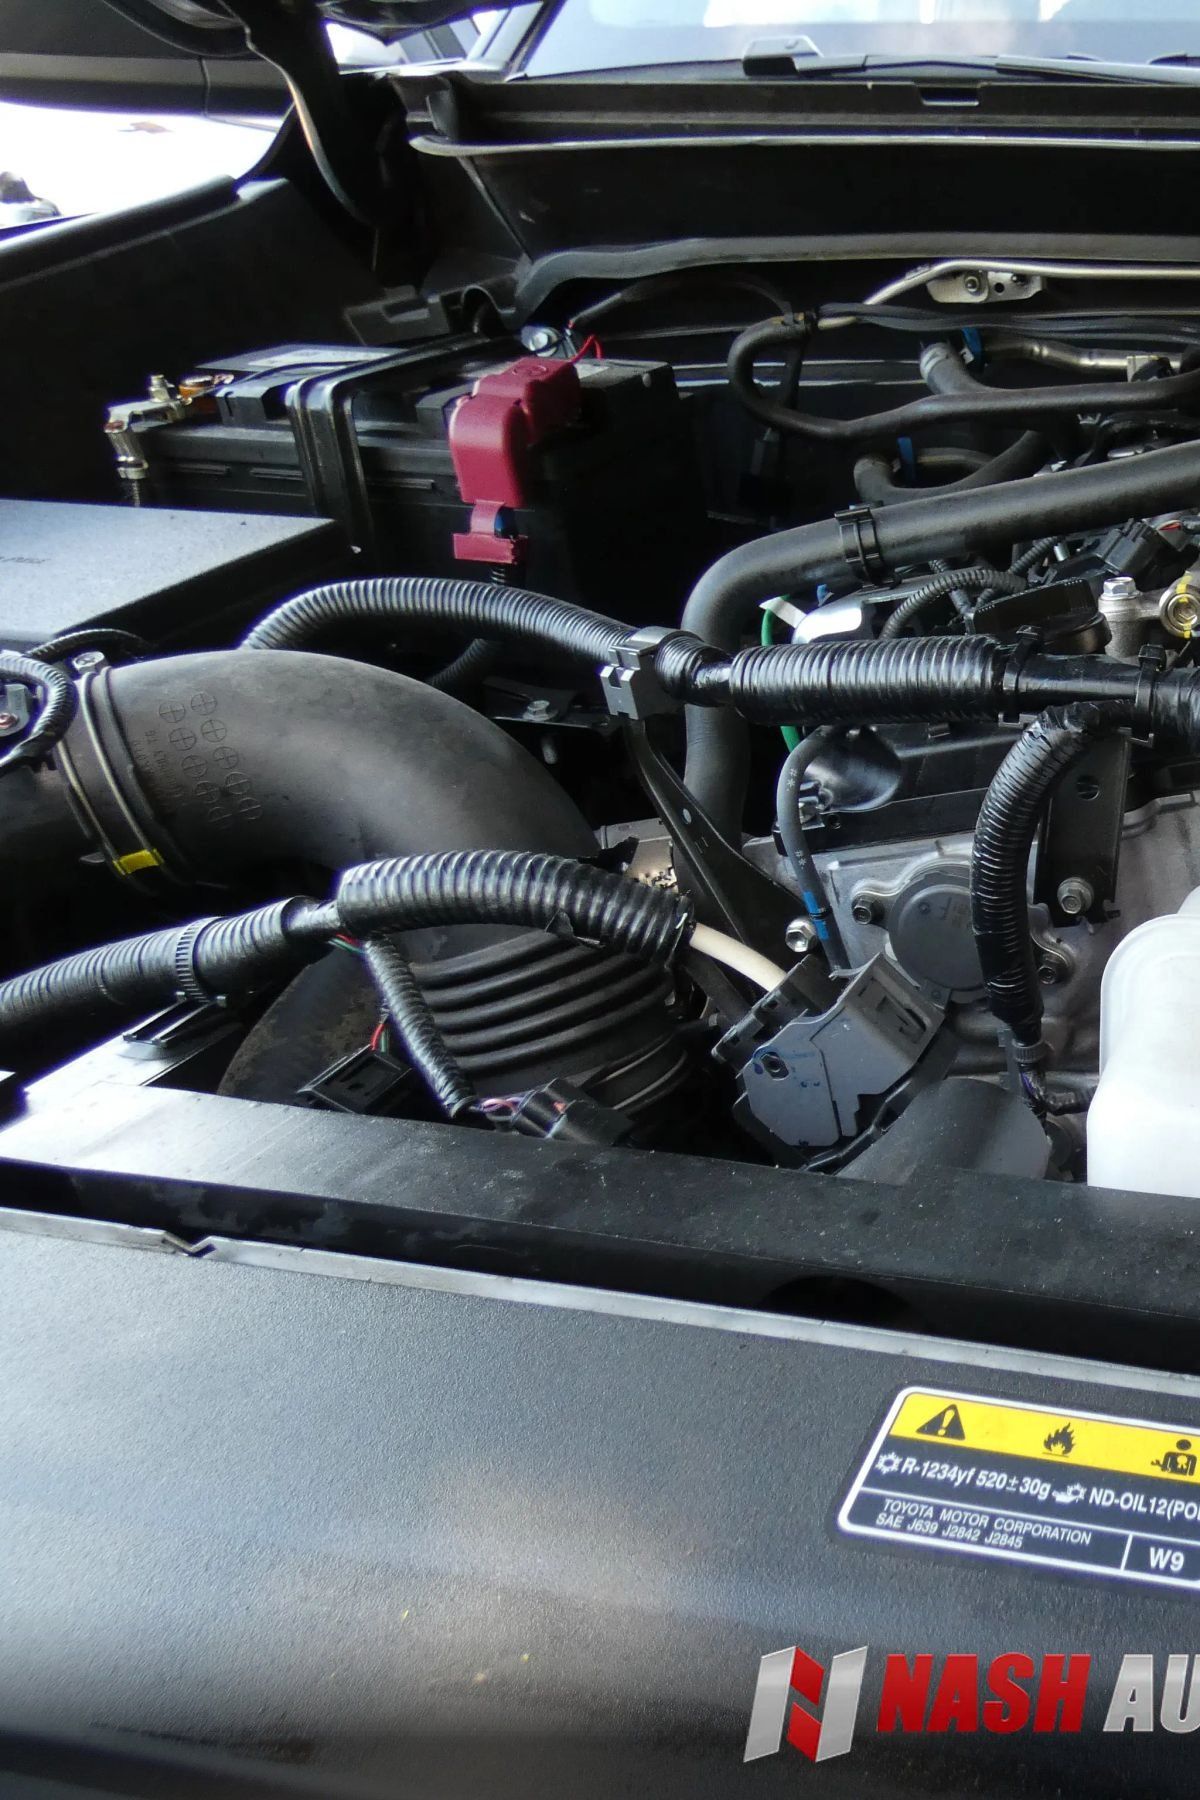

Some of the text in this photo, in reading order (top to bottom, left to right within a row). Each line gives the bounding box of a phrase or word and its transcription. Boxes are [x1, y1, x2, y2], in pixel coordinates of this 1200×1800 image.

[901, 1456, 976, 1487] R-1234yf
[876, 1512, 1024, 1549] SAE J639 J2842 J2845
[883, 1499, 1092, 1546] TOYOTA MOTOR CORPORATION
[1150, 1546, 1185, 1572] W9
